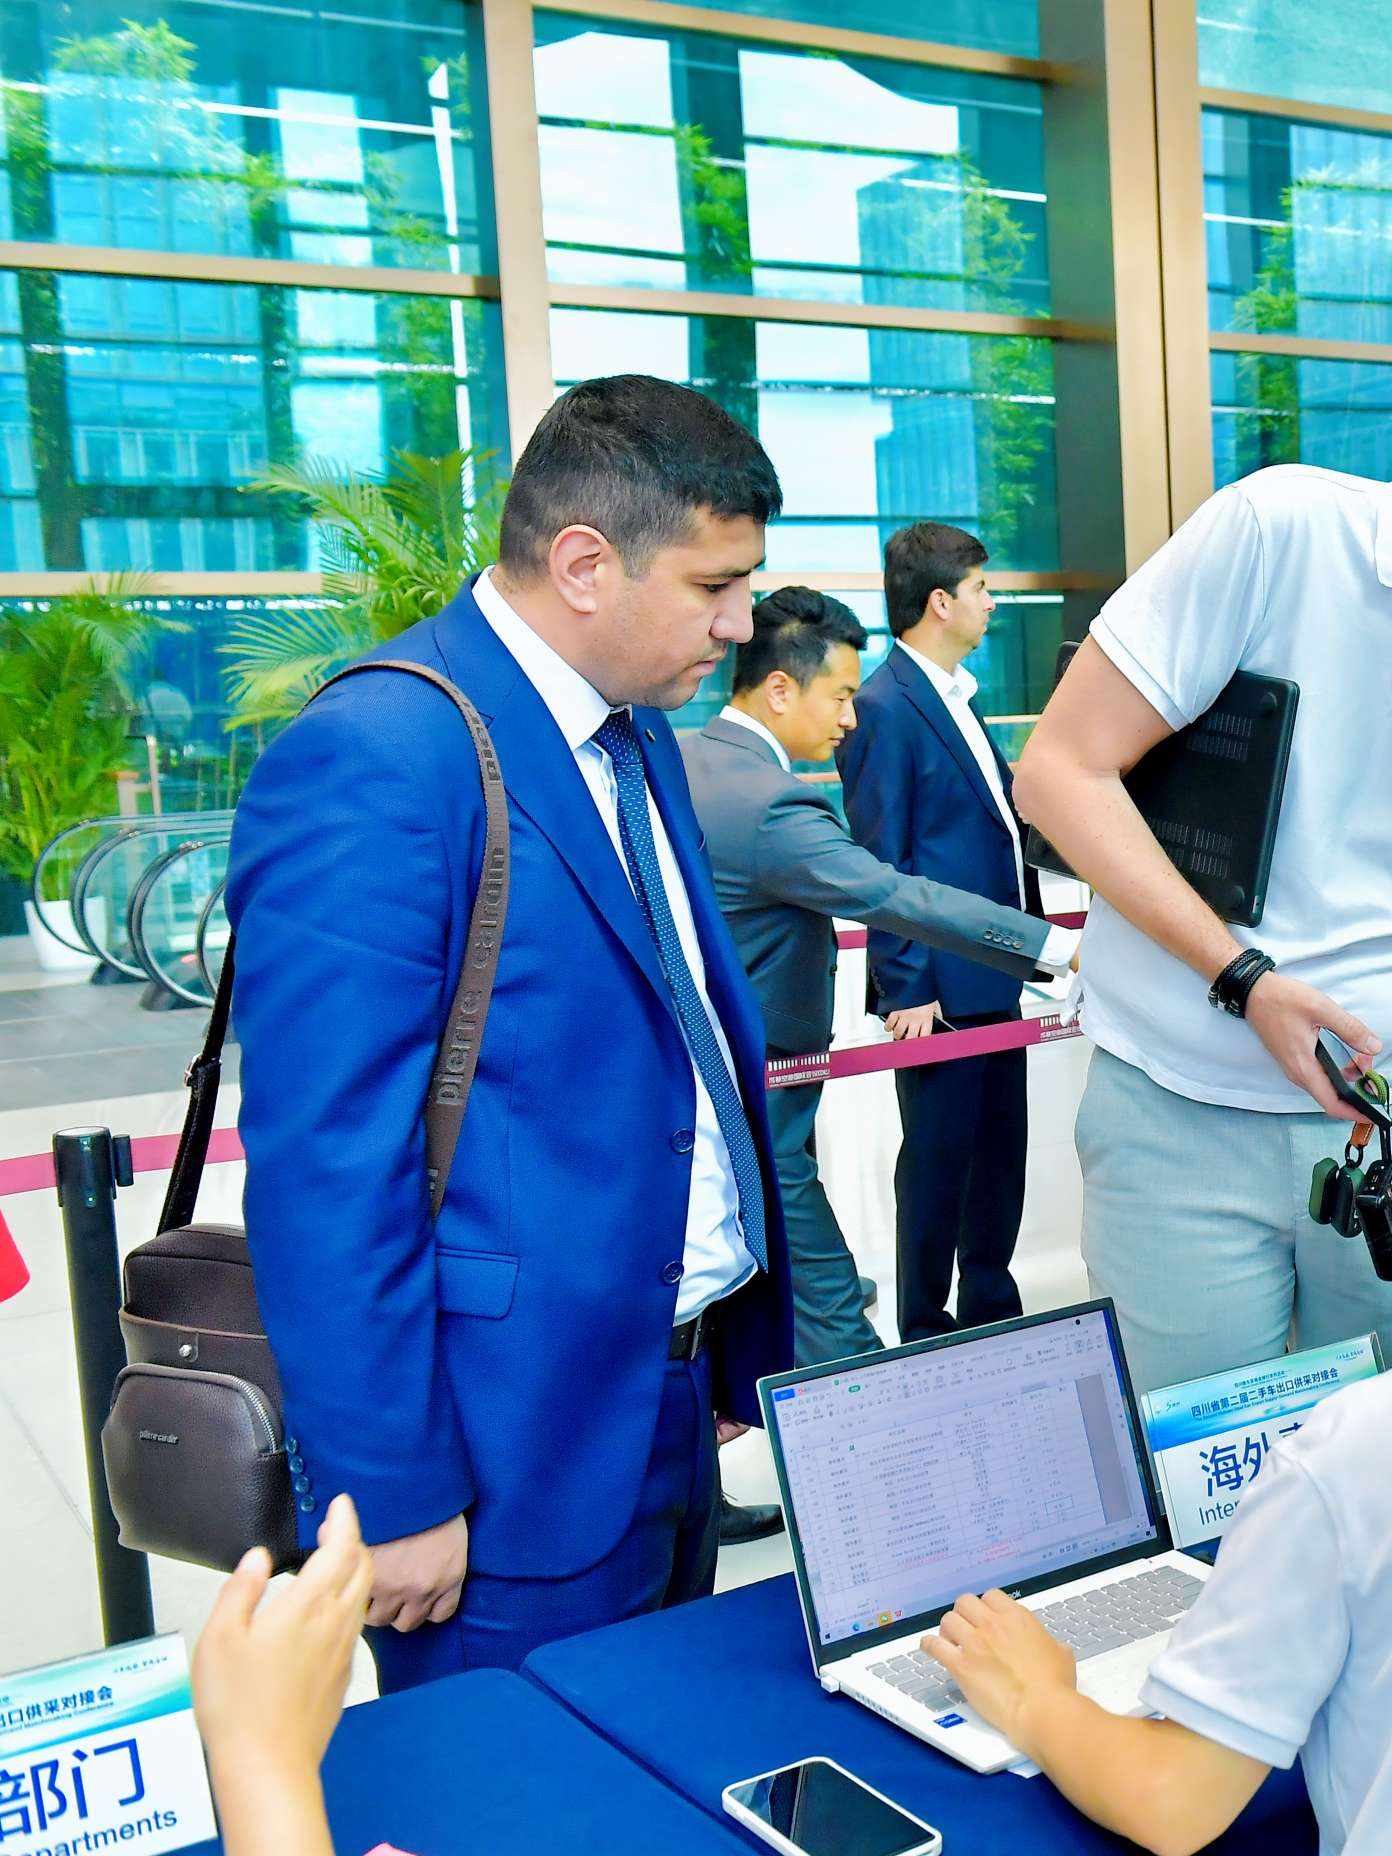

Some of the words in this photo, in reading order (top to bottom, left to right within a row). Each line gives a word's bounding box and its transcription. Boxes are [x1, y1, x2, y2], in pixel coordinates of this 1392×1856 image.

[1191, 1367, 1339, 1418] 四川省第二届二手车出口供采对接会
[1199, 1421, 1304, 1497] 海外
[1198, 1500, 1240, 1525] Inter
[0, 1738, 146, 1843] 部门
[0, 1810, 178, 1856] artments
